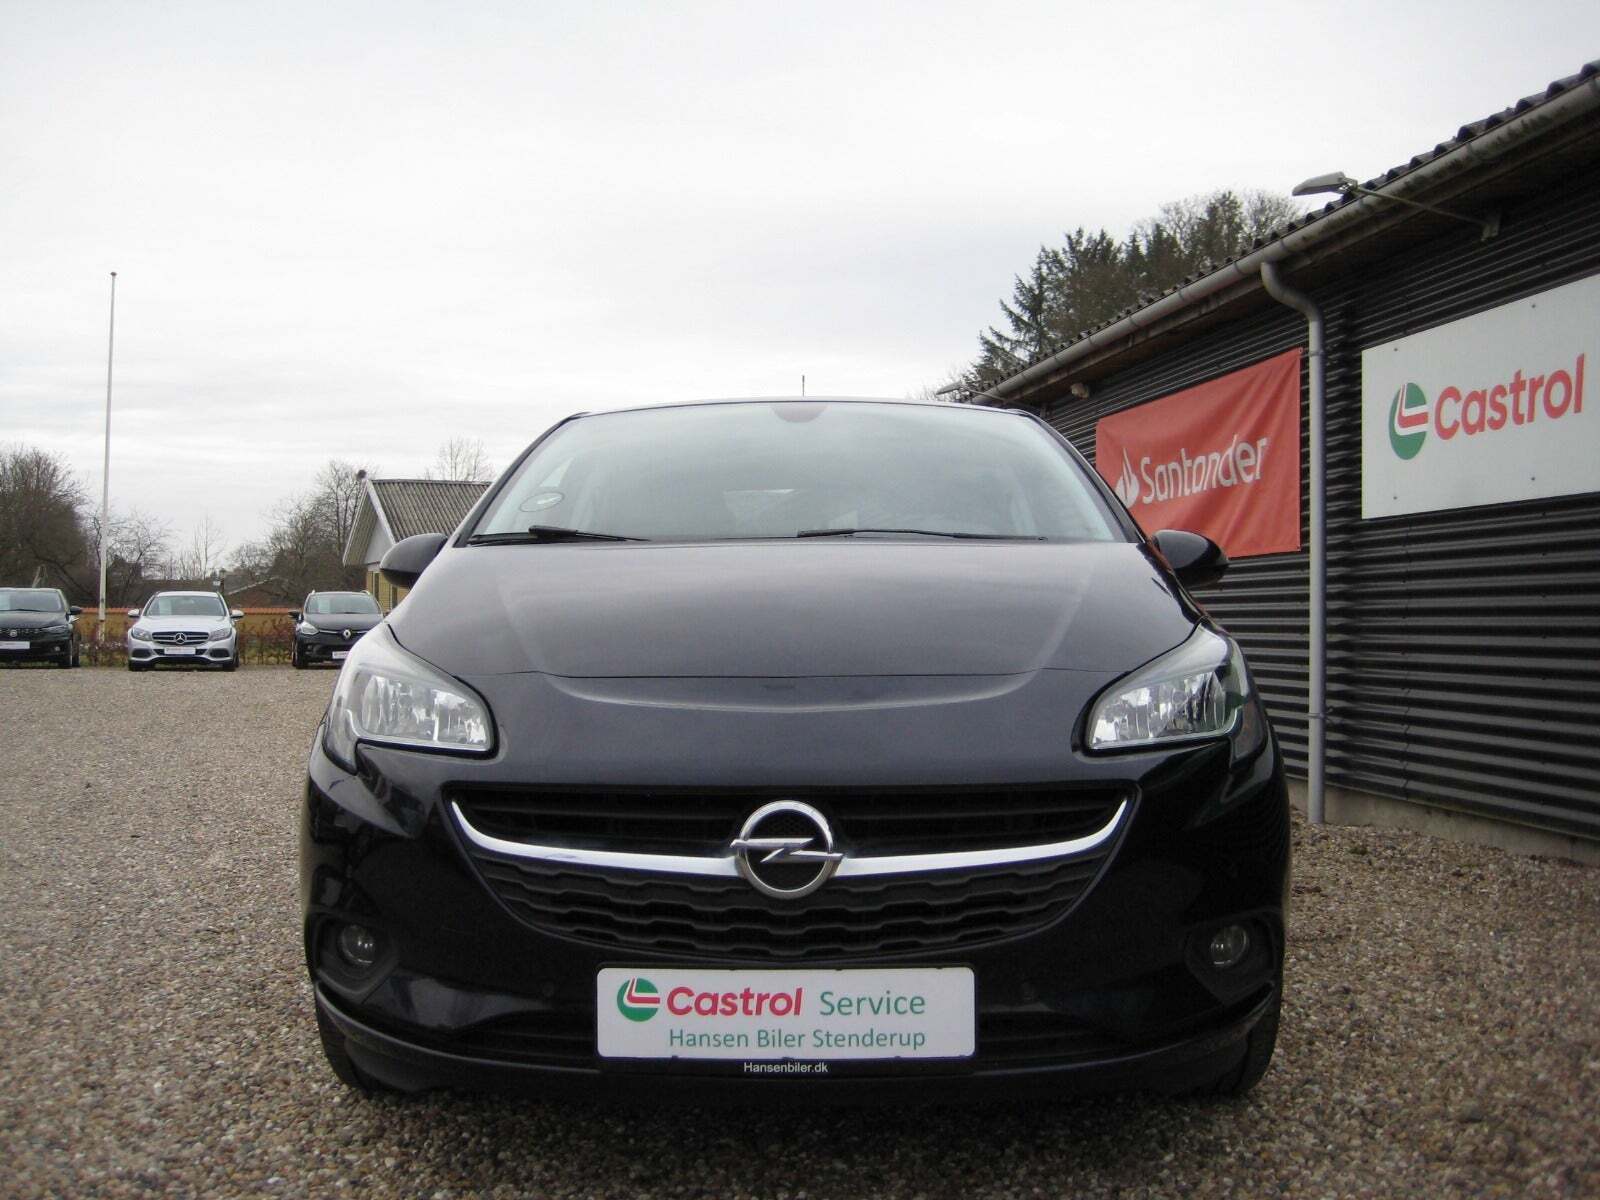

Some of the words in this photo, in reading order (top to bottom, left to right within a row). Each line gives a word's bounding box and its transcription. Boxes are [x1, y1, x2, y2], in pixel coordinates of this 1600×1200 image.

[1434, 354, 1585, 440] Castrol
[1140, 434, 1267, 504] Santander
[667, 986, 803, 1016] Castrol
[819, 990, 926, 1015] Service
[668, 1028, 749, 1048] Hansen
[756, 1028, 805, 1048] Biler
[812, 1029, 926, 1051] Stenderup
[743, 1061, 829, 1074] Hansenbiler.dk
